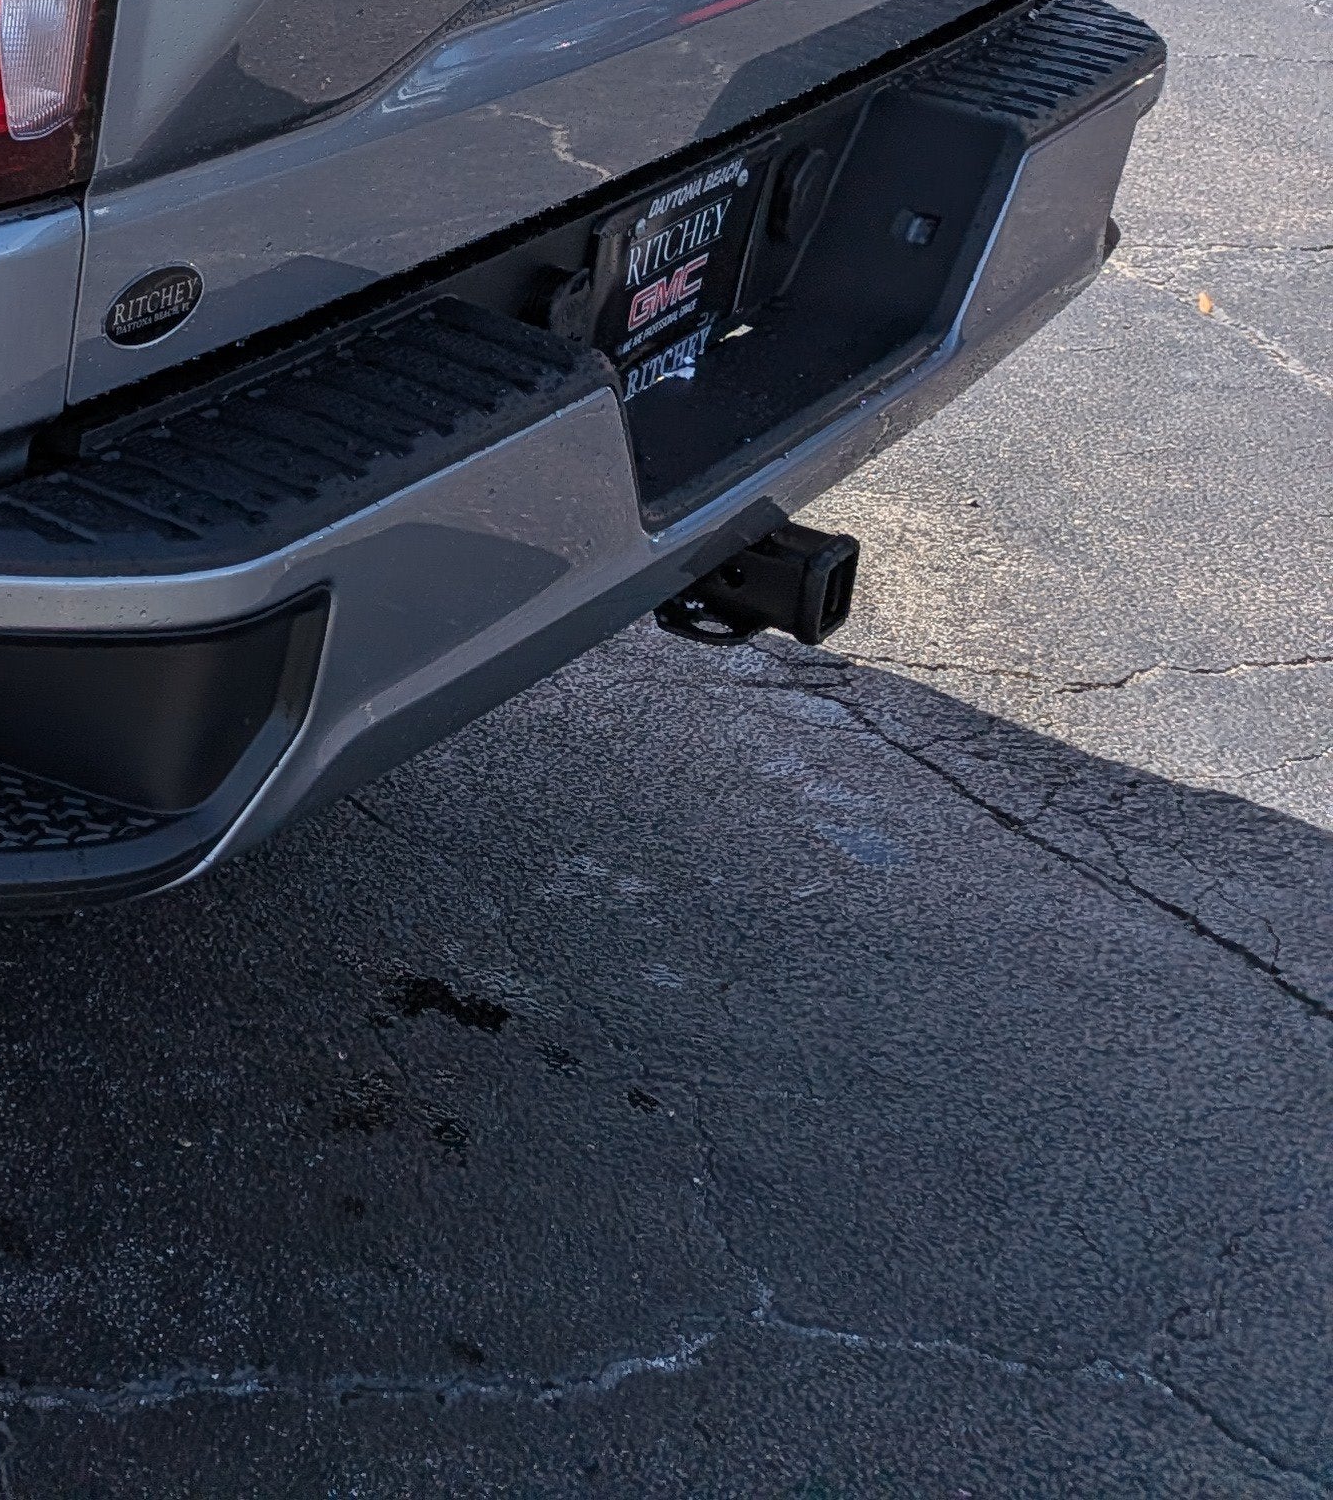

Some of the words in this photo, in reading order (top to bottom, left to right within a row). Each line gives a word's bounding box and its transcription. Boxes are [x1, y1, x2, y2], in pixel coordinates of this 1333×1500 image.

[648, 178, 703, 219] DAYTONA
[703, 156, 744, 191] BEACH
[625, 197, 732, 286] RITCHEY
[113, 277, 198, 325] RITCHEY
[628, 252, 709, 332] GMC
